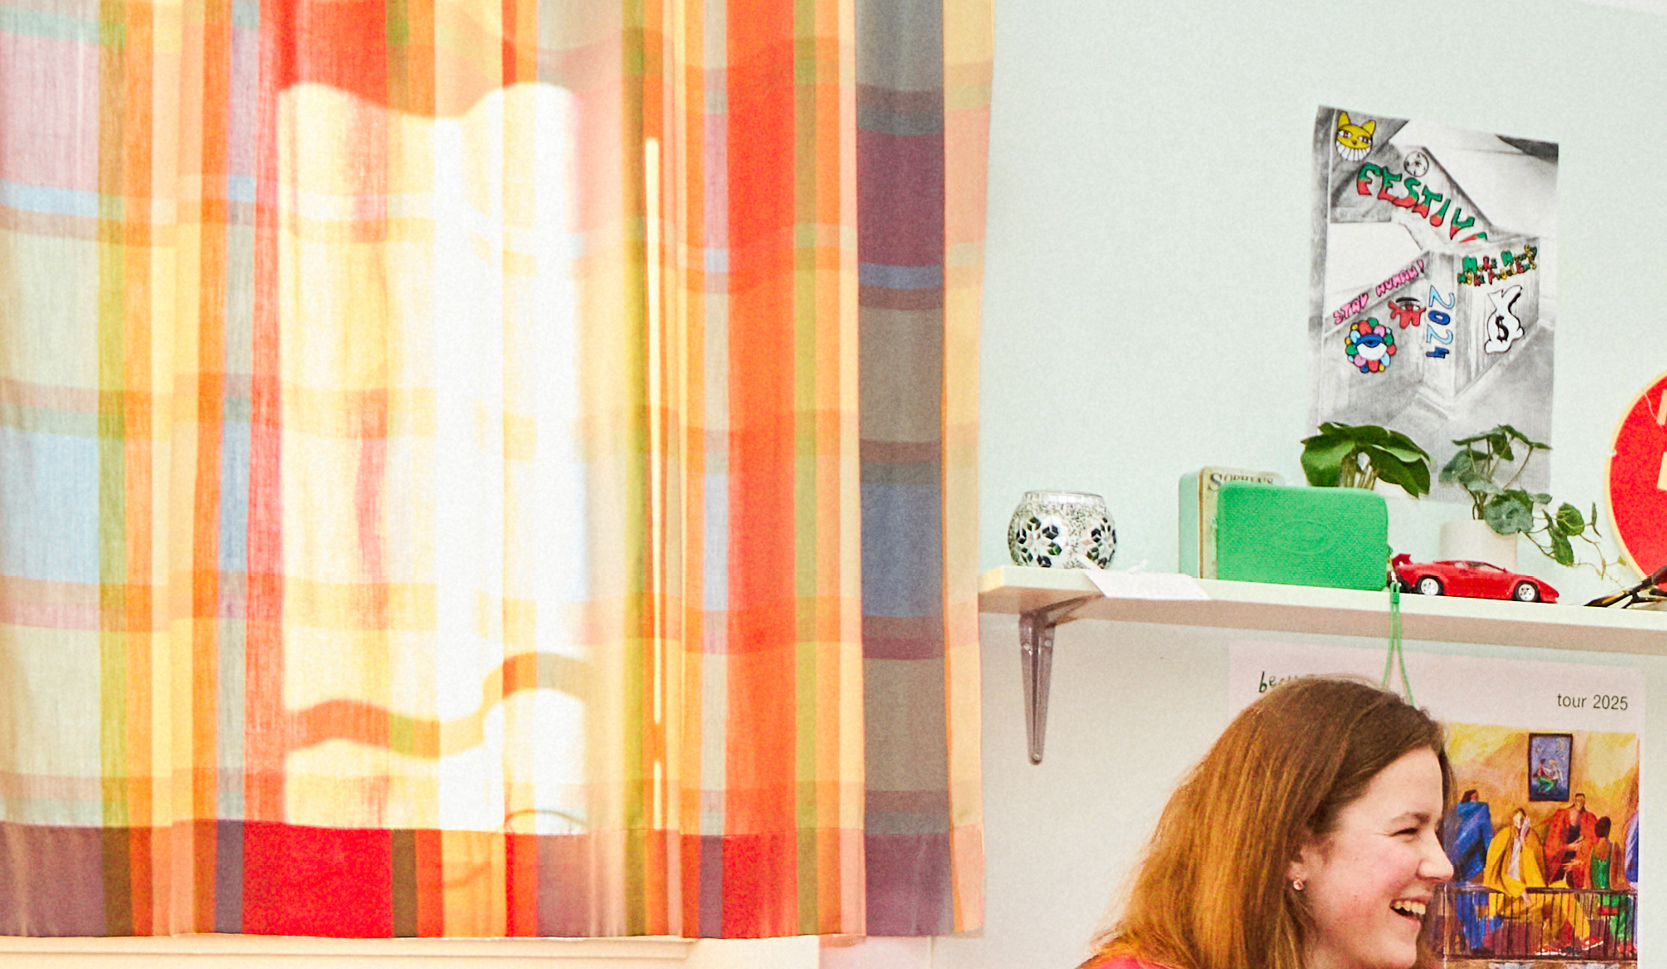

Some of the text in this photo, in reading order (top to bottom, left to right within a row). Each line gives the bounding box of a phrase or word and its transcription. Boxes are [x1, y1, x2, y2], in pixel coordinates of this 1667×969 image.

[1426, 285, 1456, 359] 2024
[1557, 693, 1629, 711] tour 2025
